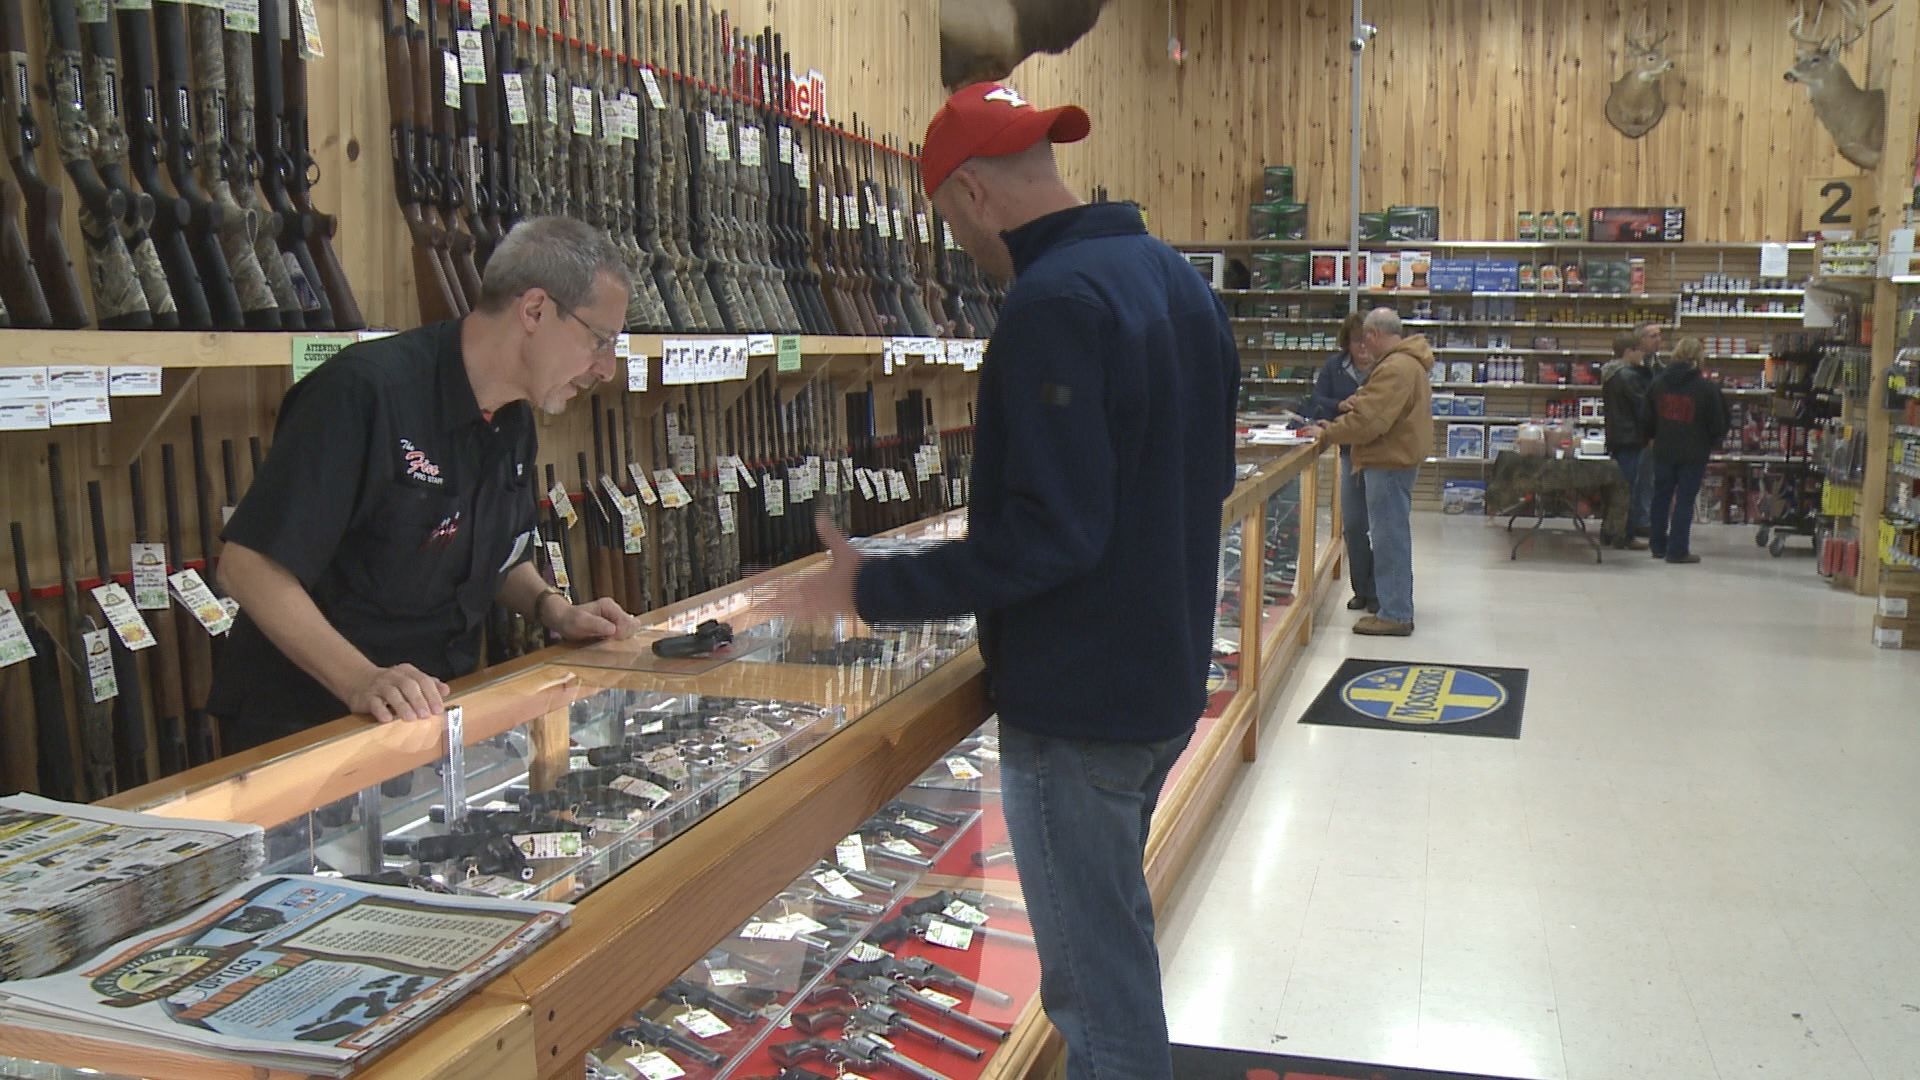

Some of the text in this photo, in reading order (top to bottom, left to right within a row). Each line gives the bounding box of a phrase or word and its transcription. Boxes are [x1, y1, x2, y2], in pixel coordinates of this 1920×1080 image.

[1820, 182, 1852, 224] 2
[304, 353, 337, 361] CUSTOM
[194, 957, 262, 990] OPTICS
